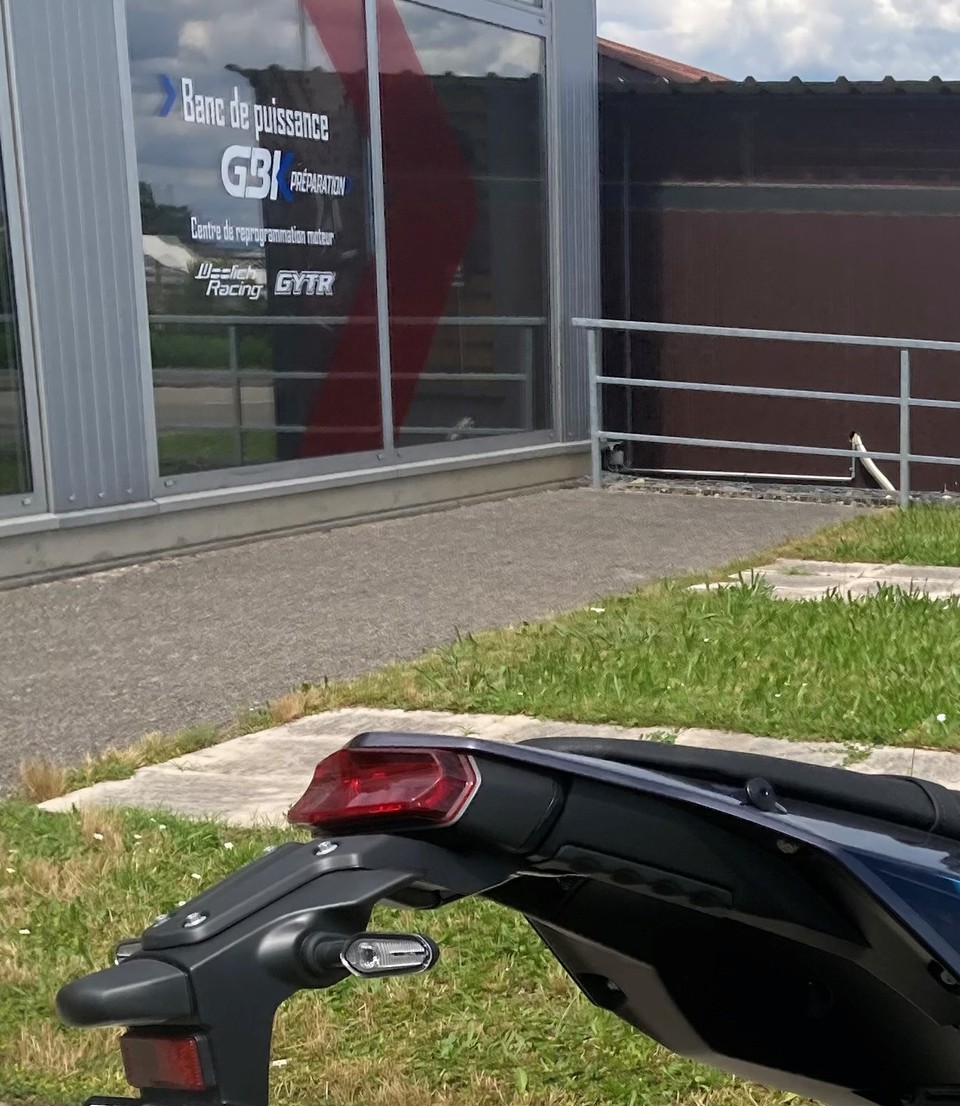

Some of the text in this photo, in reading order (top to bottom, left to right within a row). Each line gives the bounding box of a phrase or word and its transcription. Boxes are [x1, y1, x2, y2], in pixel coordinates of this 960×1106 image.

[181, 78, 330, 141] Banc de puissance
[221, 144, 346, 203] GBK PRÉPARATION
[190, 216, 335, 247] Centre de reprogrammation moteur
[206, 280, 264, 300] Racing
[274, 269, 336, 296] GYTR
